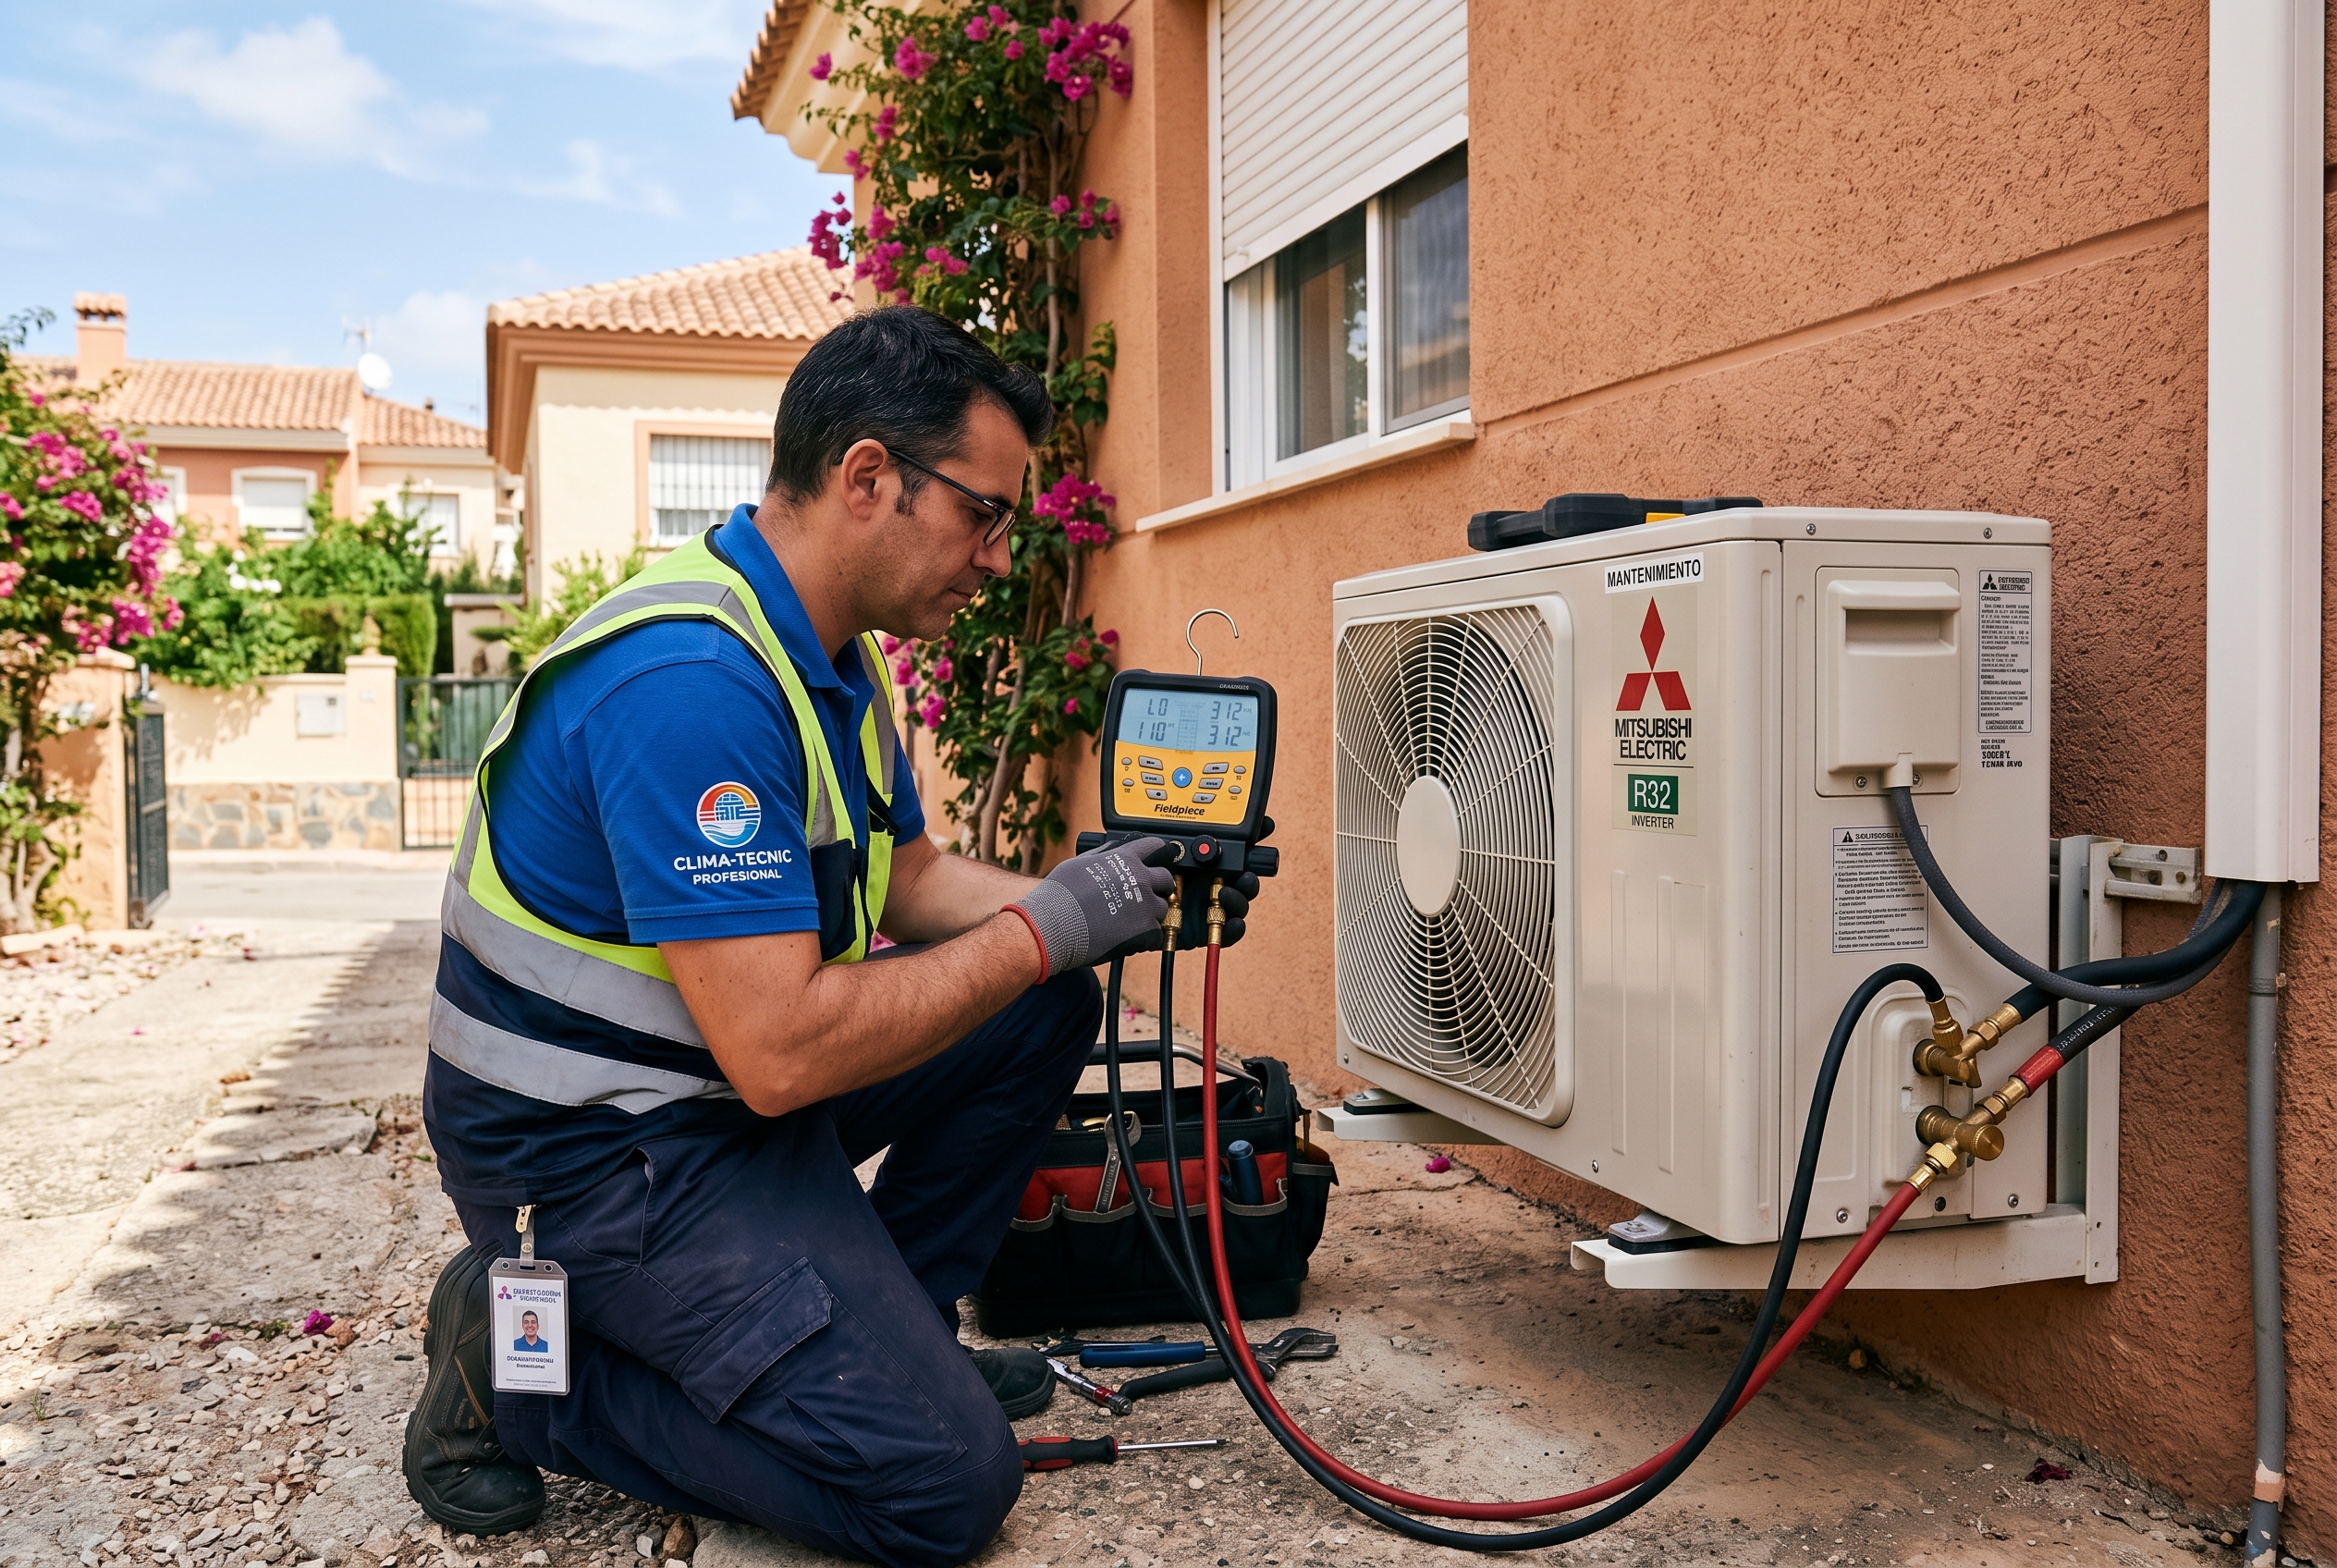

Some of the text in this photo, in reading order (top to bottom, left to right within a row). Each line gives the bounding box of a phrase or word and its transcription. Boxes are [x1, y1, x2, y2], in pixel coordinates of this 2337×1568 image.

[1607, 558, 1701, 588] MANTENIMIENTO
[1615, 717, 1692, 740] MITSUBISHI
[1620, 740, 1686, 761] ELECTRIC
[1633, 778, 1671, 810] R32
[1154, 803, 1205, 815] Fieldpiece
[1632, 815, 1674, 829] INVERTER
[673, 849, 792, 871] CLIMA-TECNIC
[692, 868, 782, 886] PROFESIONAL
